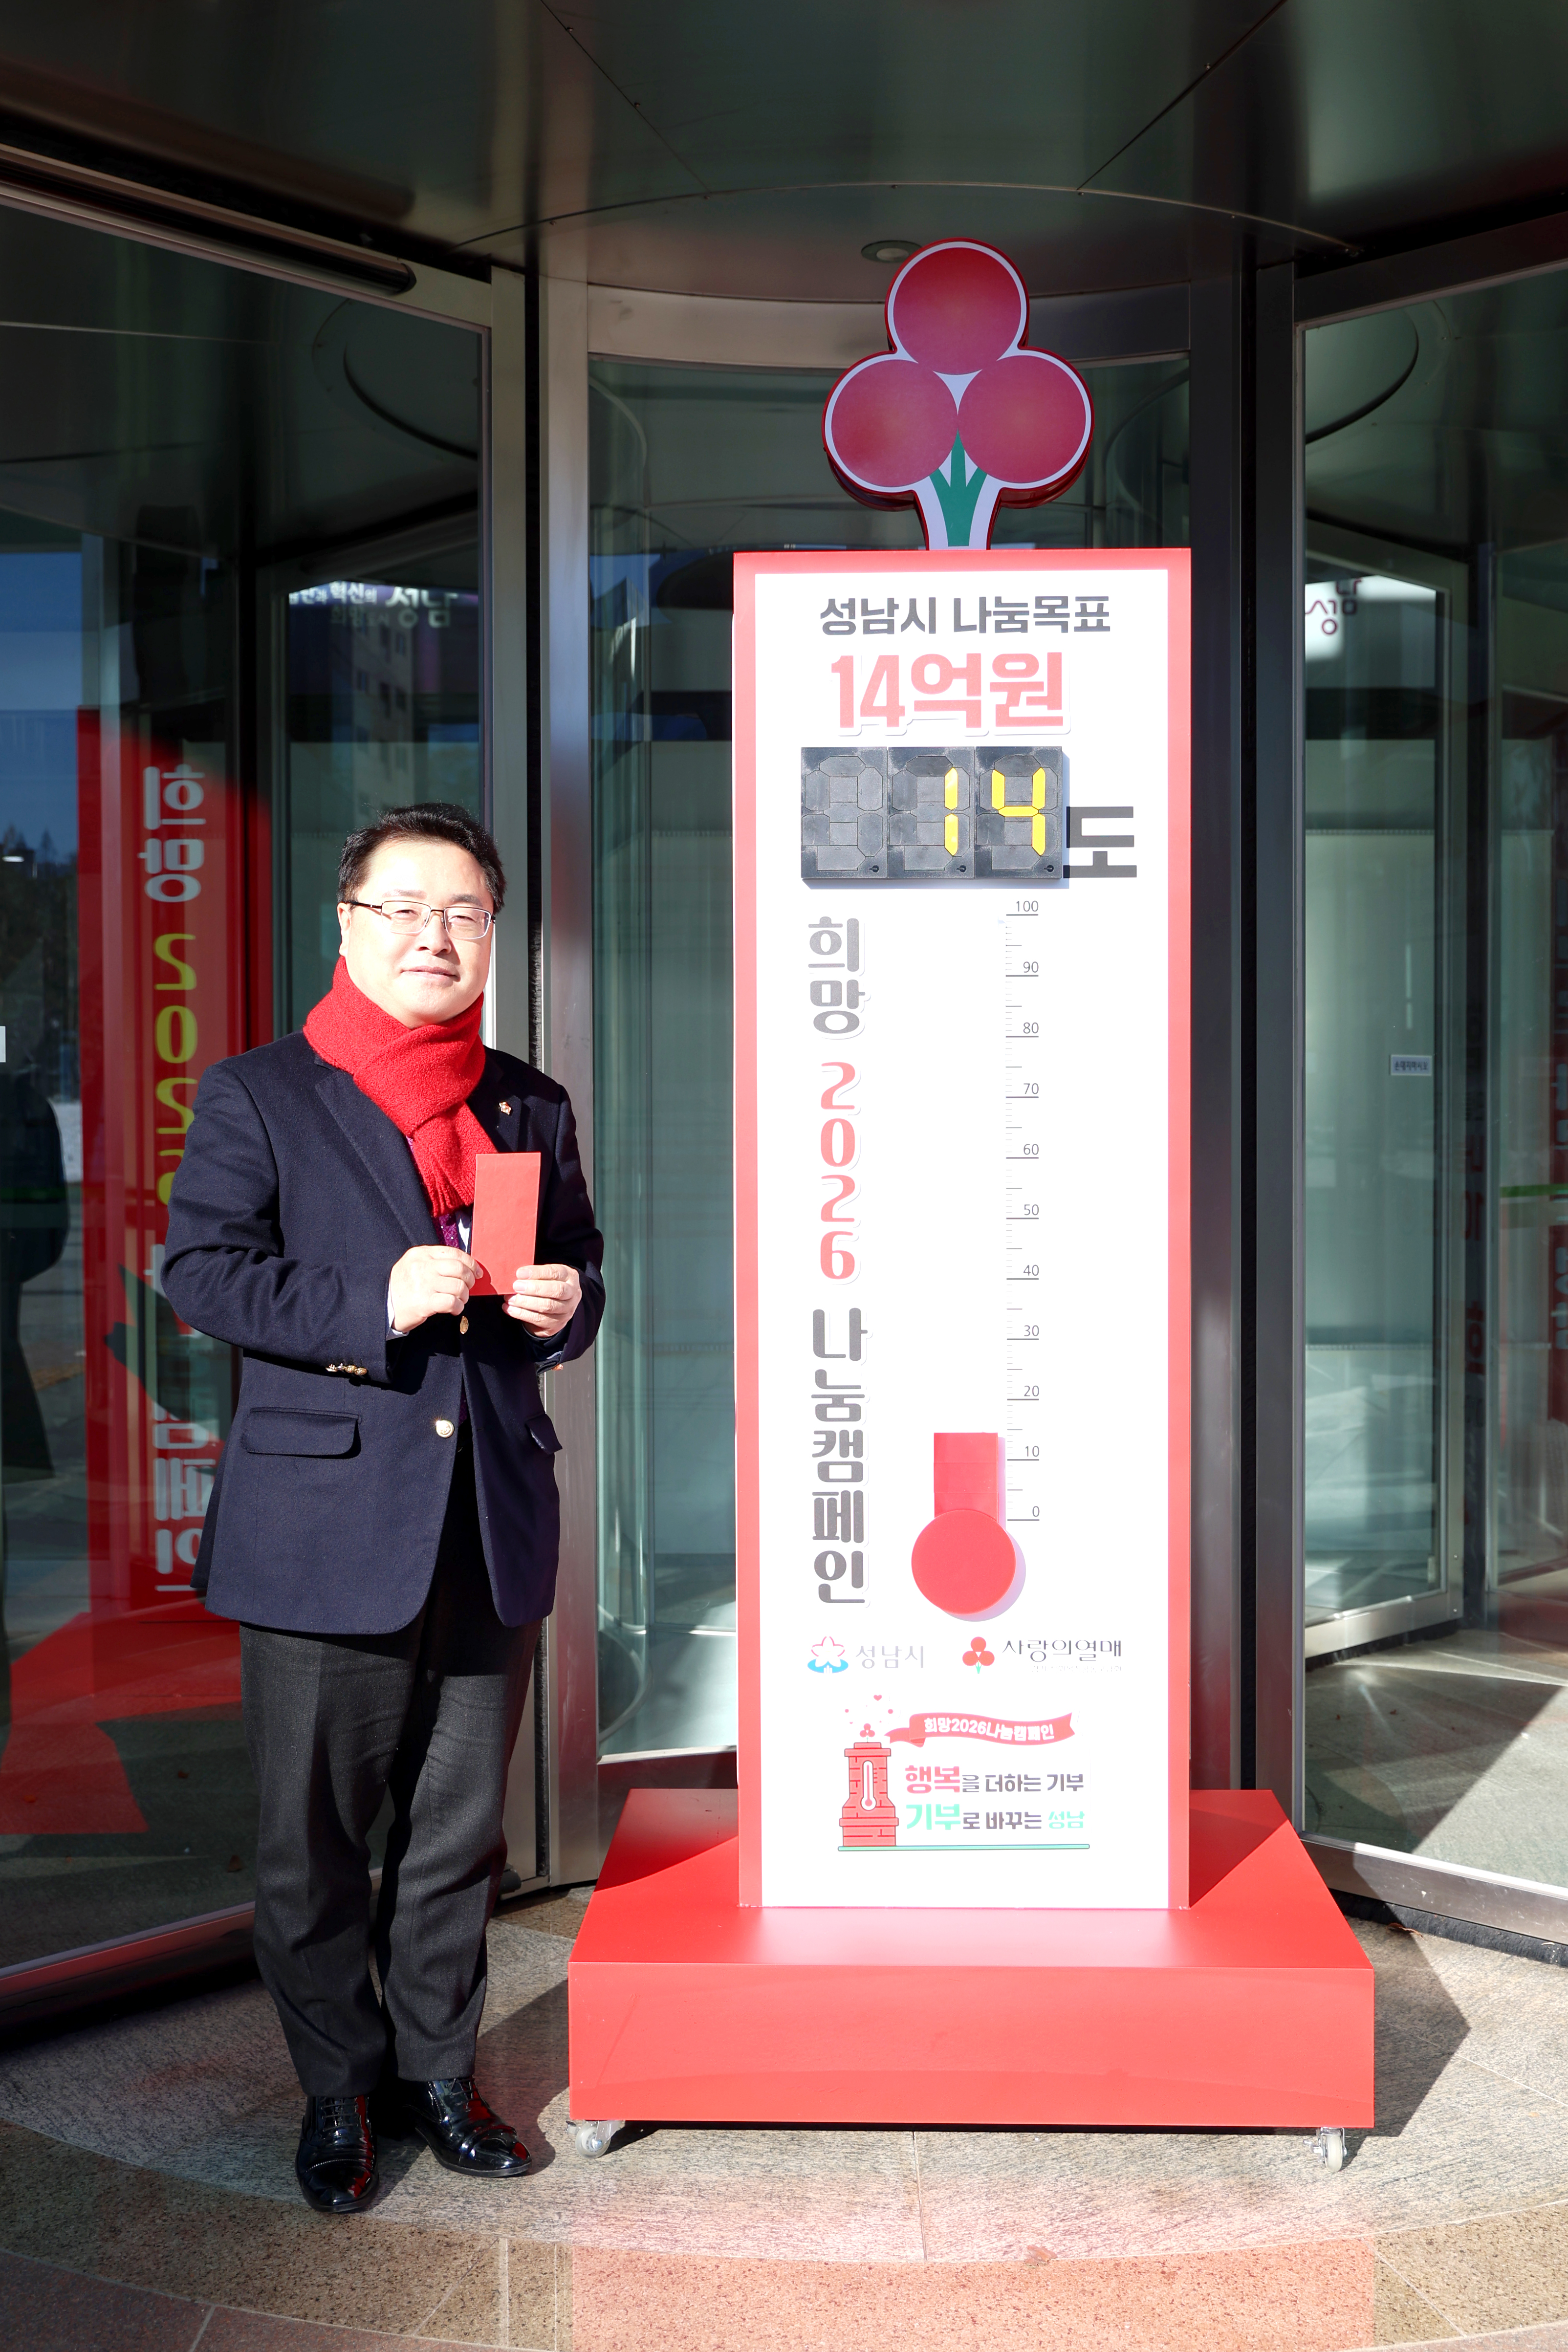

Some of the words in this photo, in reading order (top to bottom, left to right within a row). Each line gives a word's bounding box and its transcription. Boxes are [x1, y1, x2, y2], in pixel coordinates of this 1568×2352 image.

[820, 598, 936, 635] 성남시
[954, 597, 1111, 633] 나눔목표
[832, 653, 1064, 728] 14억원
[944, 767, 1045, 856] 14
[1063, 806, 1137, 879] 도
[1015, 901, 1039, 913] 100
[809, 917, 866, 1034] 희망
[1024, 961, 1040, 974] 90
[1023, 1023, 1040, 1035] 80
[1024, 1083, 1040, 1095] 70
[1024, 1144, 1040, 1156] 60
[821, 1063, 855, 1280] 2026
[1024, 1204, 1040, 1216] 50
[1024, 1265, 1040, 1277] 40
[1024, 1325, 1040, 1337] 30
[1024, 1386, 1040, 1397] 20
[812, 1308, 868, 1604] 나눔캠페인
[1025, 1446, 1040, 1458] 10
[1032, 1506, 1041, 1518] 0
[857, 1646, 924, 1669] 성남시
[1003, 1639, 1121, 1662] 사랑의열매
[906, 1765, 980, 1794] 행복을
[986, 1774, 1041, 1792] 더하는
[1047, 1774, 1084, 1792] 기부
[907, 1804, 980, 1830] 기부로
[986, 1812, 1042, 1830] 바꾸는
[1049, 1811, 1085, 1829] 성남
